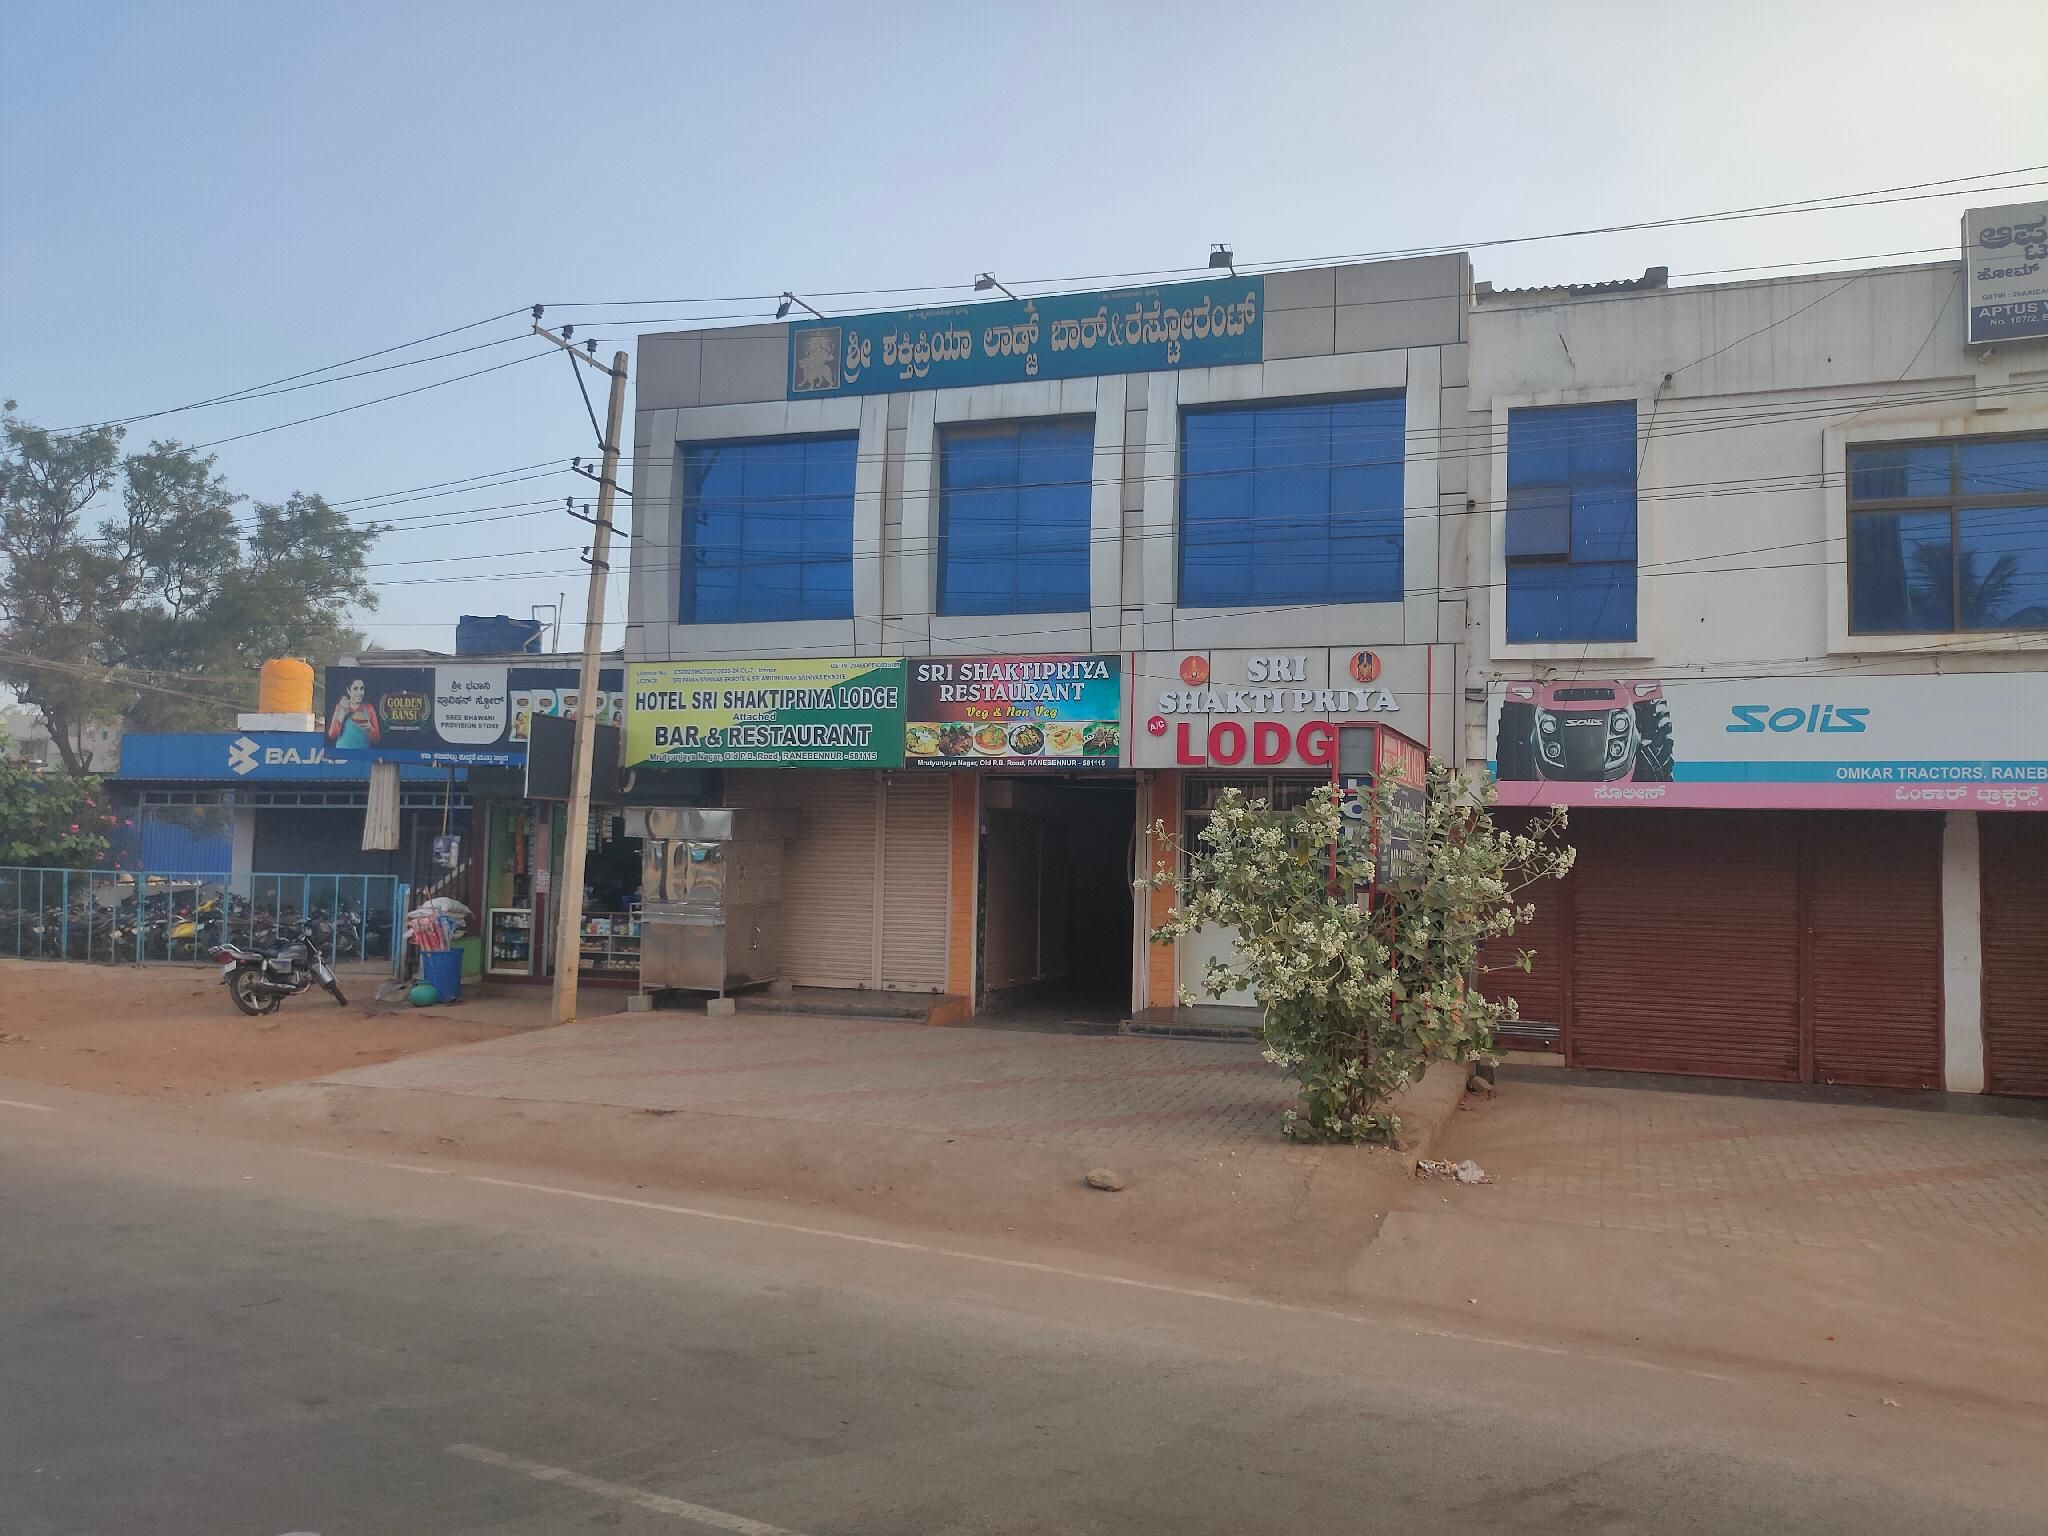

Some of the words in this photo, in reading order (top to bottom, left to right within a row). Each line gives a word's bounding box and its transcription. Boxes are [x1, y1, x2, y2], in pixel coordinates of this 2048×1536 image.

[1979, 302, 2039, 318] APTUS
[844, 331, 872, 384] ಶ್ರೀ
[917, 664, 954, 682] SRI
[959, 661, 1110, 682] SHAKTIPRIYA
[1247, 655, 1308, 683] SRI
[387, 697, 422, 708] GOLDEN
[635, 691, 687, 711] HOTEL
[691, 690, 718, 710] SRI
[723, 688, 835, 710] SHAKTIPRIYA
[838, 687, 899, 709] LODGE
[939, 683, 1085, 703] RESTAURANT
[1159, 689, 1286, 714] SHAKTI
[1292, 688, 1400, 713] PRIYA
[733, 711, 777, 721] Attached
[966, 706, 989, 720] Veg
[993, 706, 1002, 717] &
[1035, 706, 1059, 720] Veg
[655, 725, 700, 747] BAR
[705, 726, 723, 747] &
[728, 724, 873, 747] RESTAURANT
[1149, 719, 1166, 732] A/C
[1176, 720, 1335, 766] LODG
[1836, 767, 1894, 780] OMKAR
[1895, 785, 1968, 801] ಓಂಕಾರ್
